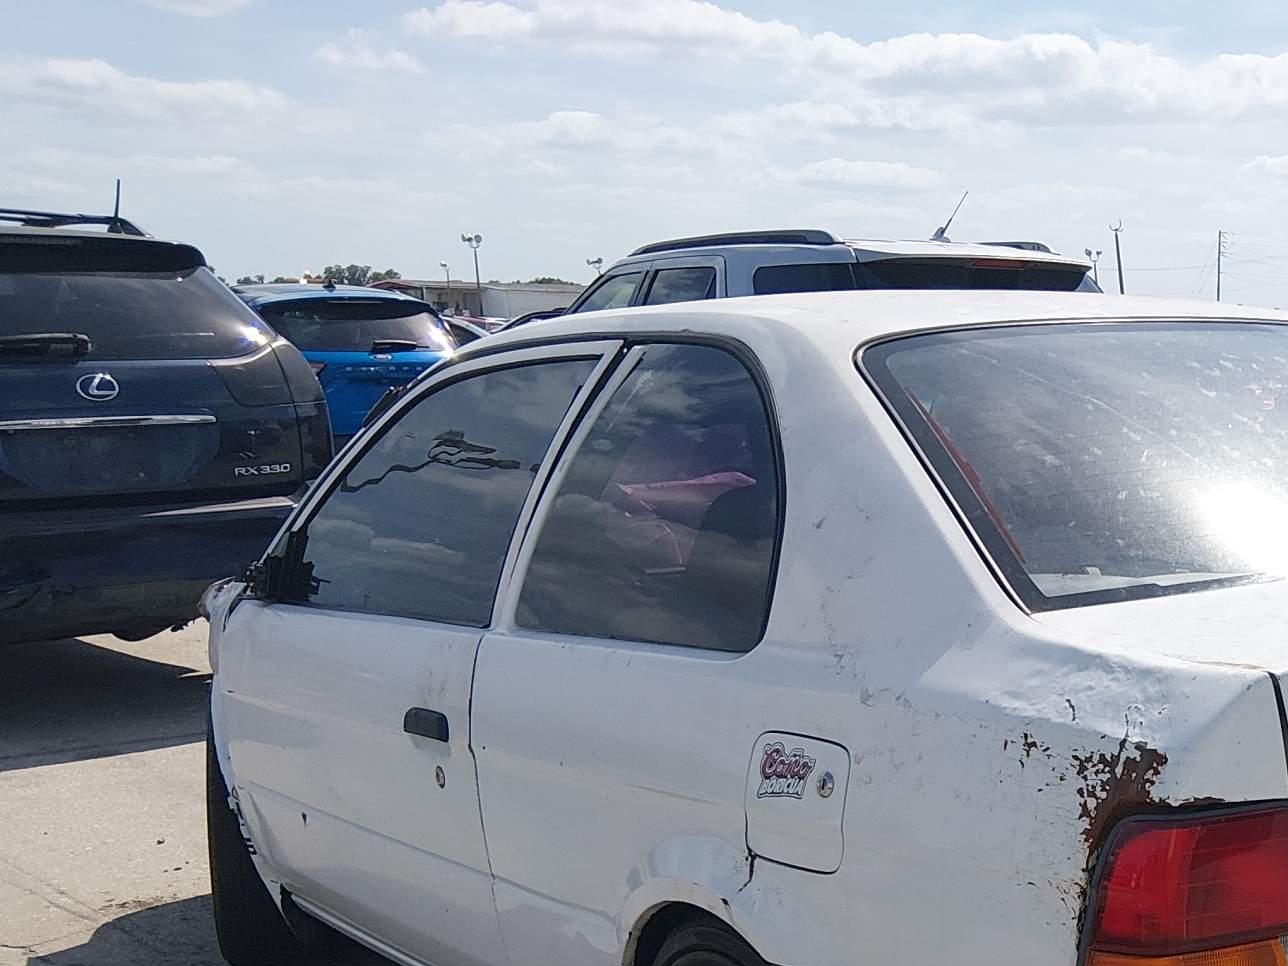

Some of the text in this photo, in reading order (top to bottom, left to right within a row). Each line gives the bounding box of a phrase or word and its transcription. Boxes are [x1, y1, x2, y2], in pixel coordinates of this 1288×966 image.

[234, 463, 291, 476] RX 330
[758, 778, 804, 796] BORICUA
